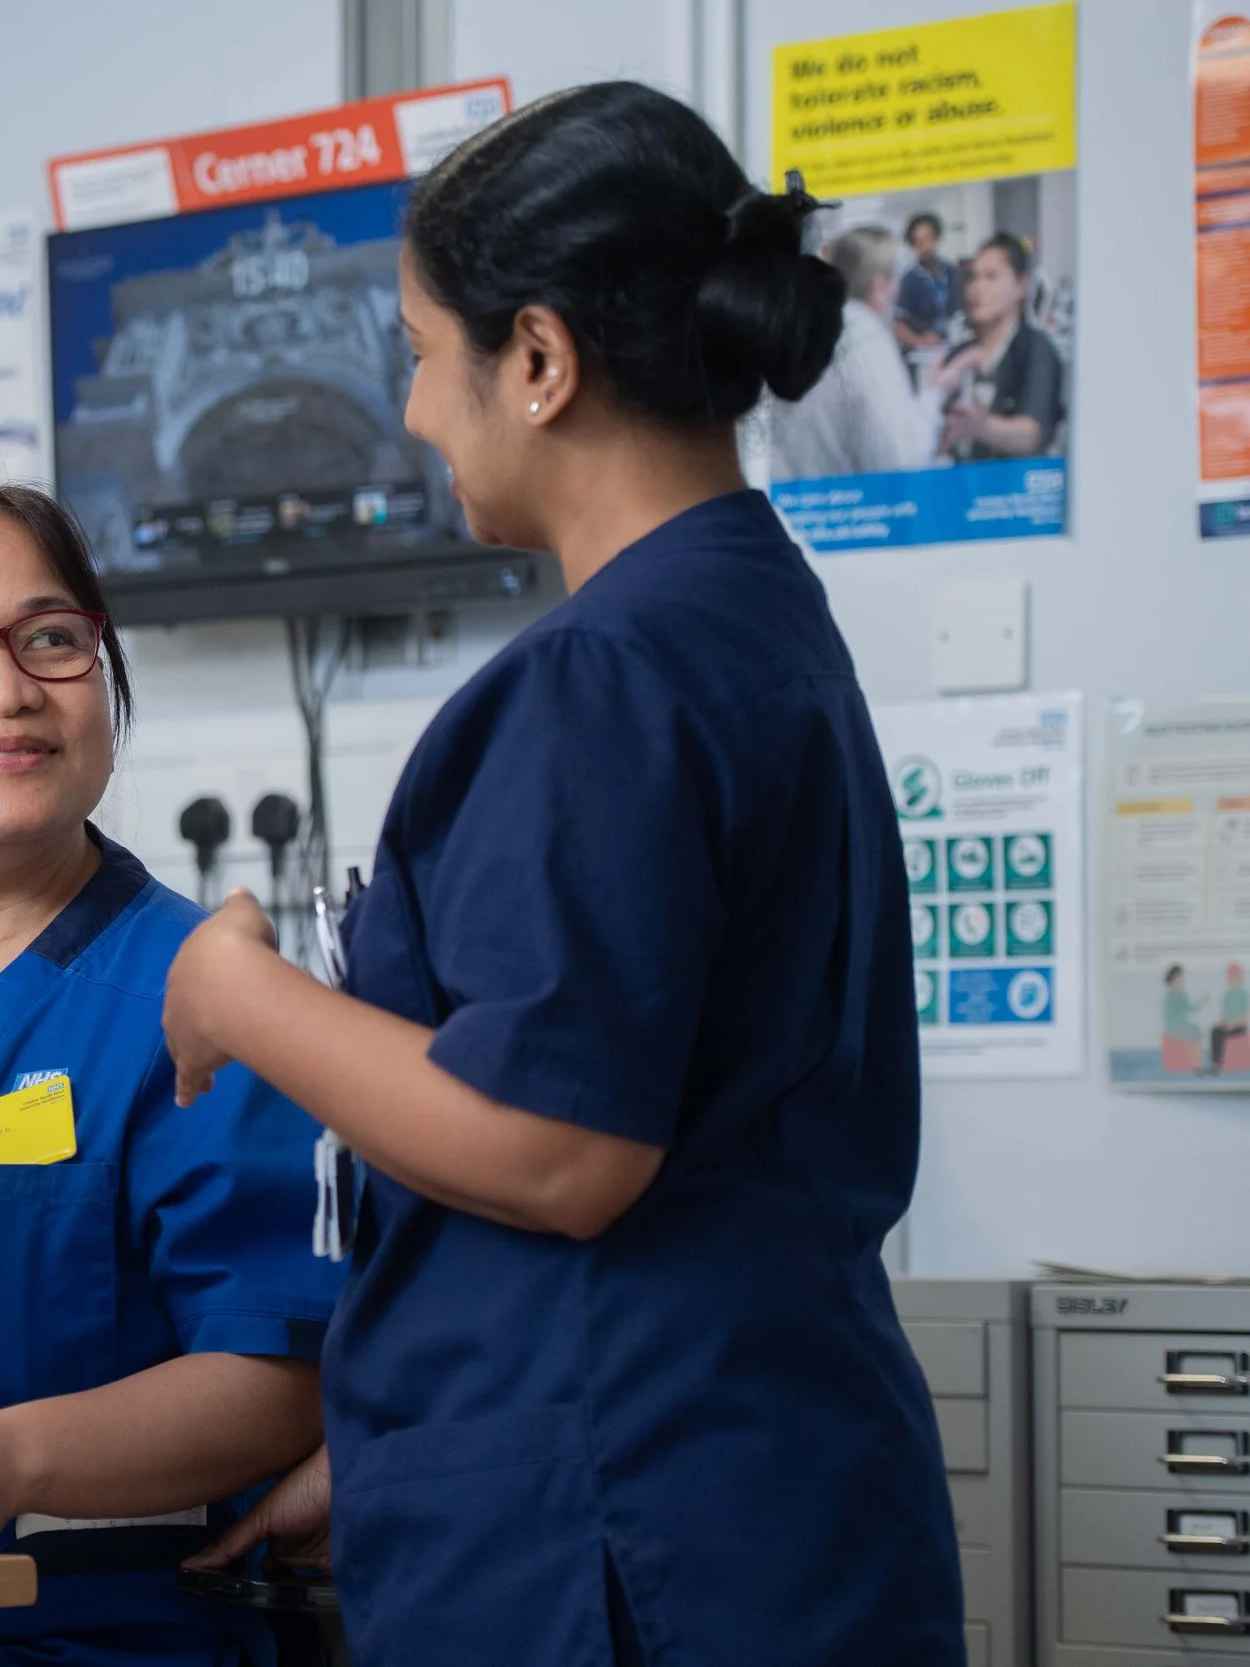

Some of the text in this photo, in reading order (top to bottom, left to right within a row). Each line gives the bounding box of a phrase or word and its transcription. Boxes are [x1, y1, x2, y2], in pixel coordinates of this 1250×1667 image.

[790, 44, 919, 80] We do not
[791, 80, 888, 110] tolerate
[792, 97, 1003, 141] violence or abuse.
[192, 145, 306, 194] Cerner
[311, 125, 380, 174] 724
